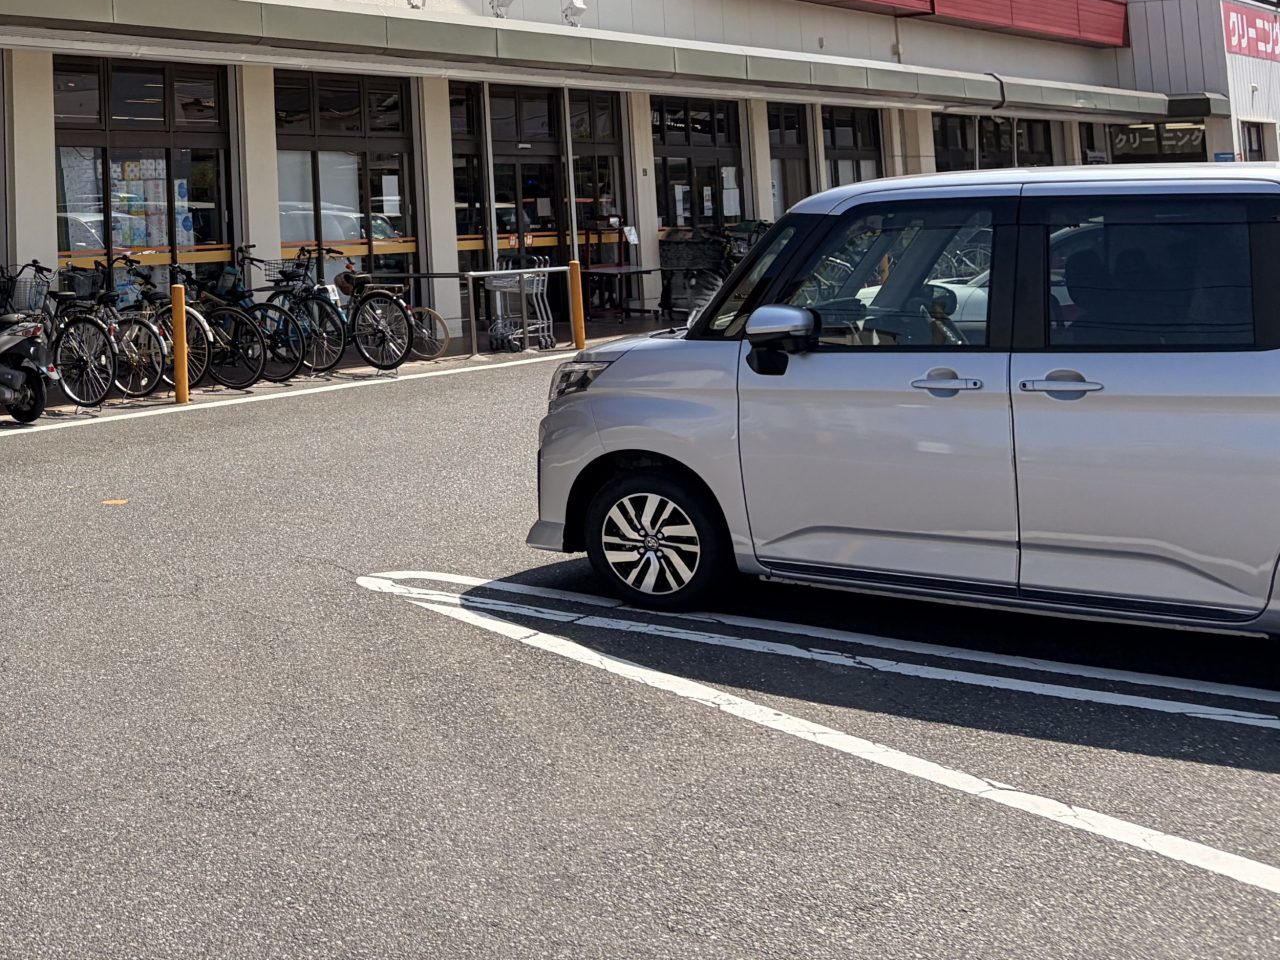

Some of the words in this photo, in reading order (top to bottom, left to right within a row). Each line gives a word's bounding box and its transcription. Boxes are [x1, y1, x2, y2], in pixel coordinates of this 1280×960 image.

[1115, 130, 1203, 149] クリーニング
